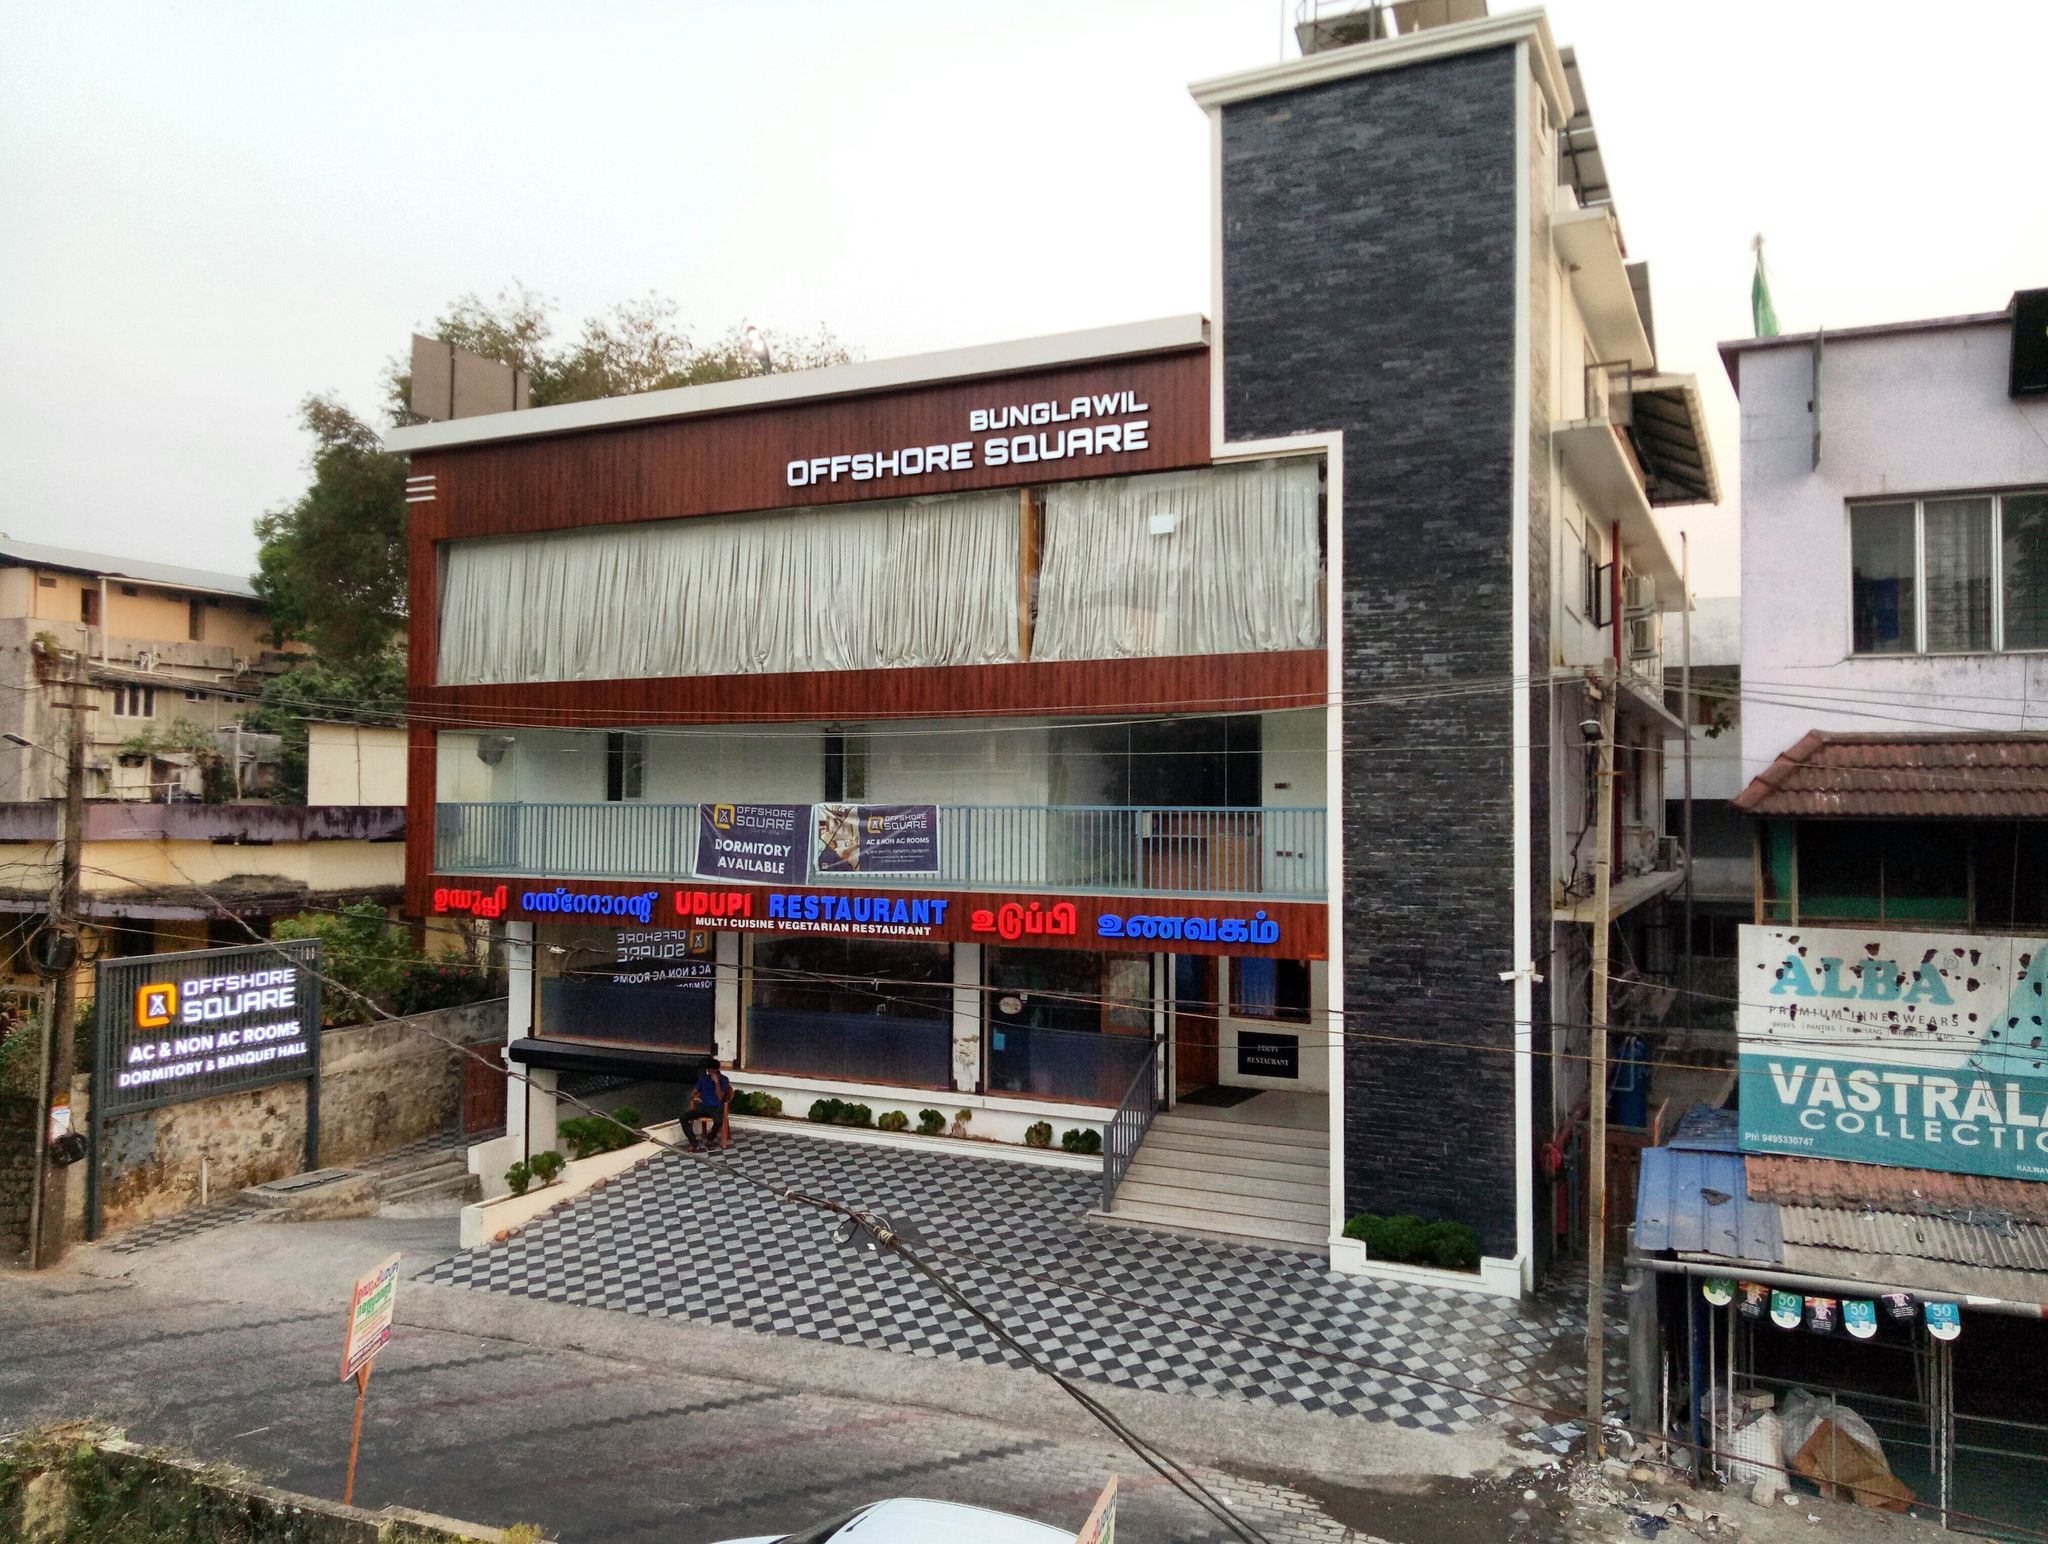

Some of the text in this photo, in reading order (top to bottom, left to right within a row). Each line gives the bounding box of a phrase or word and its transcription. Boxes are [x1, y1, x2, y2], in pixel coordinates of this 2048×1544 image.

[970, 391, 1149, 431] BUNGLAWIL
[787, 420, 1149, 487] OFFSHORE SQUARE
[736, 815, 794, 831] SQUARE
[737, 806, 795, 819] OFFSHORE
[884, 813, 927, 822] OFFSHORE
[884, 820, 928, 831] SQUARE
[715, 838, 791, 858] DORMITORY
[717, 856, 785, 874] AVAILABLE
[434, 884, 508, 918] ഉഡുപ്പി
[674, 891, 949, 925] UDUPI RESTAURANT
[695, 917, 931, 936] MULTI CUISINE VEGETARIAN RESTAURANT
[971, 902, 1280, 945] உடுப்பி உணவகம்
[183, 968, 297, 997] OFFSHORE
[1769, 953, 1956, 1006] ALBA
[183, 986, 296, 1023] SQUARE
[1769, 1005, 1842, 1019] PRMIUM
[129, 1021, 300, 1064] AC & NON AC ROOMS
[119, 1042, 308, 1088] DORMITORY & BANQUET HALL
[1246, 1056, 1288, 1066] RESTAURANT
[1768, 1063, 2048, 1128] VASTRAL
[1850, 1303, 1869, 1316] 50
[1933, 1304, 1952, 1317] 50
